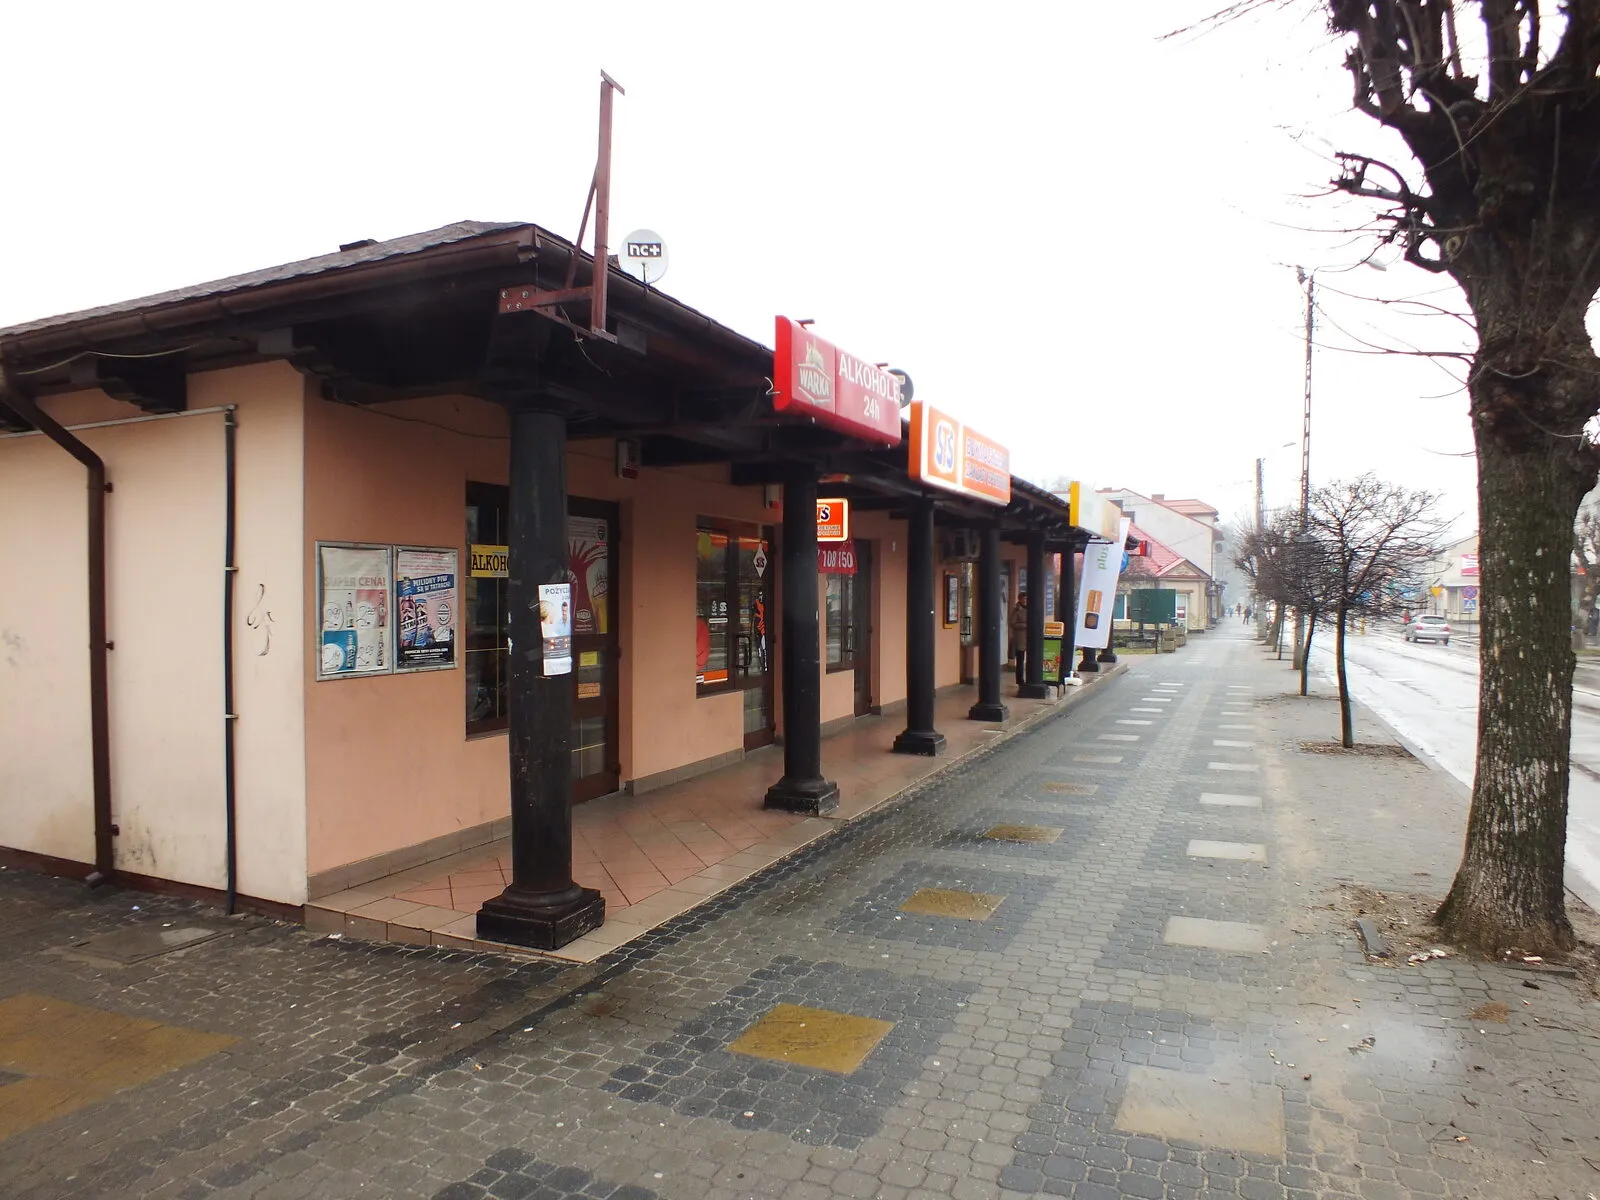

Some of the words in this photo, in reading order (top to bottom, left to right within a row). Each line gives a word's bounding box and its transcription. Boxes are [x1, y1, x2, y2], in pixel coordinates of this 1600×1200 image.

[629, 244, 660, 256] nc+
[800, 367, 830, 397] WARKA
[839, 354, 899, 401] ALKOHOLE
[863, 396, 880, 419] 24h
[935, 423, 955, 468] STS
[471, 554, 509, 571] ALKOH
[823, 550, 837, 568] 108
[838, 551, 854, 569] 150
[1097, 546, 1109, 570] plus
[358, 576, 386, 588] CENA!
